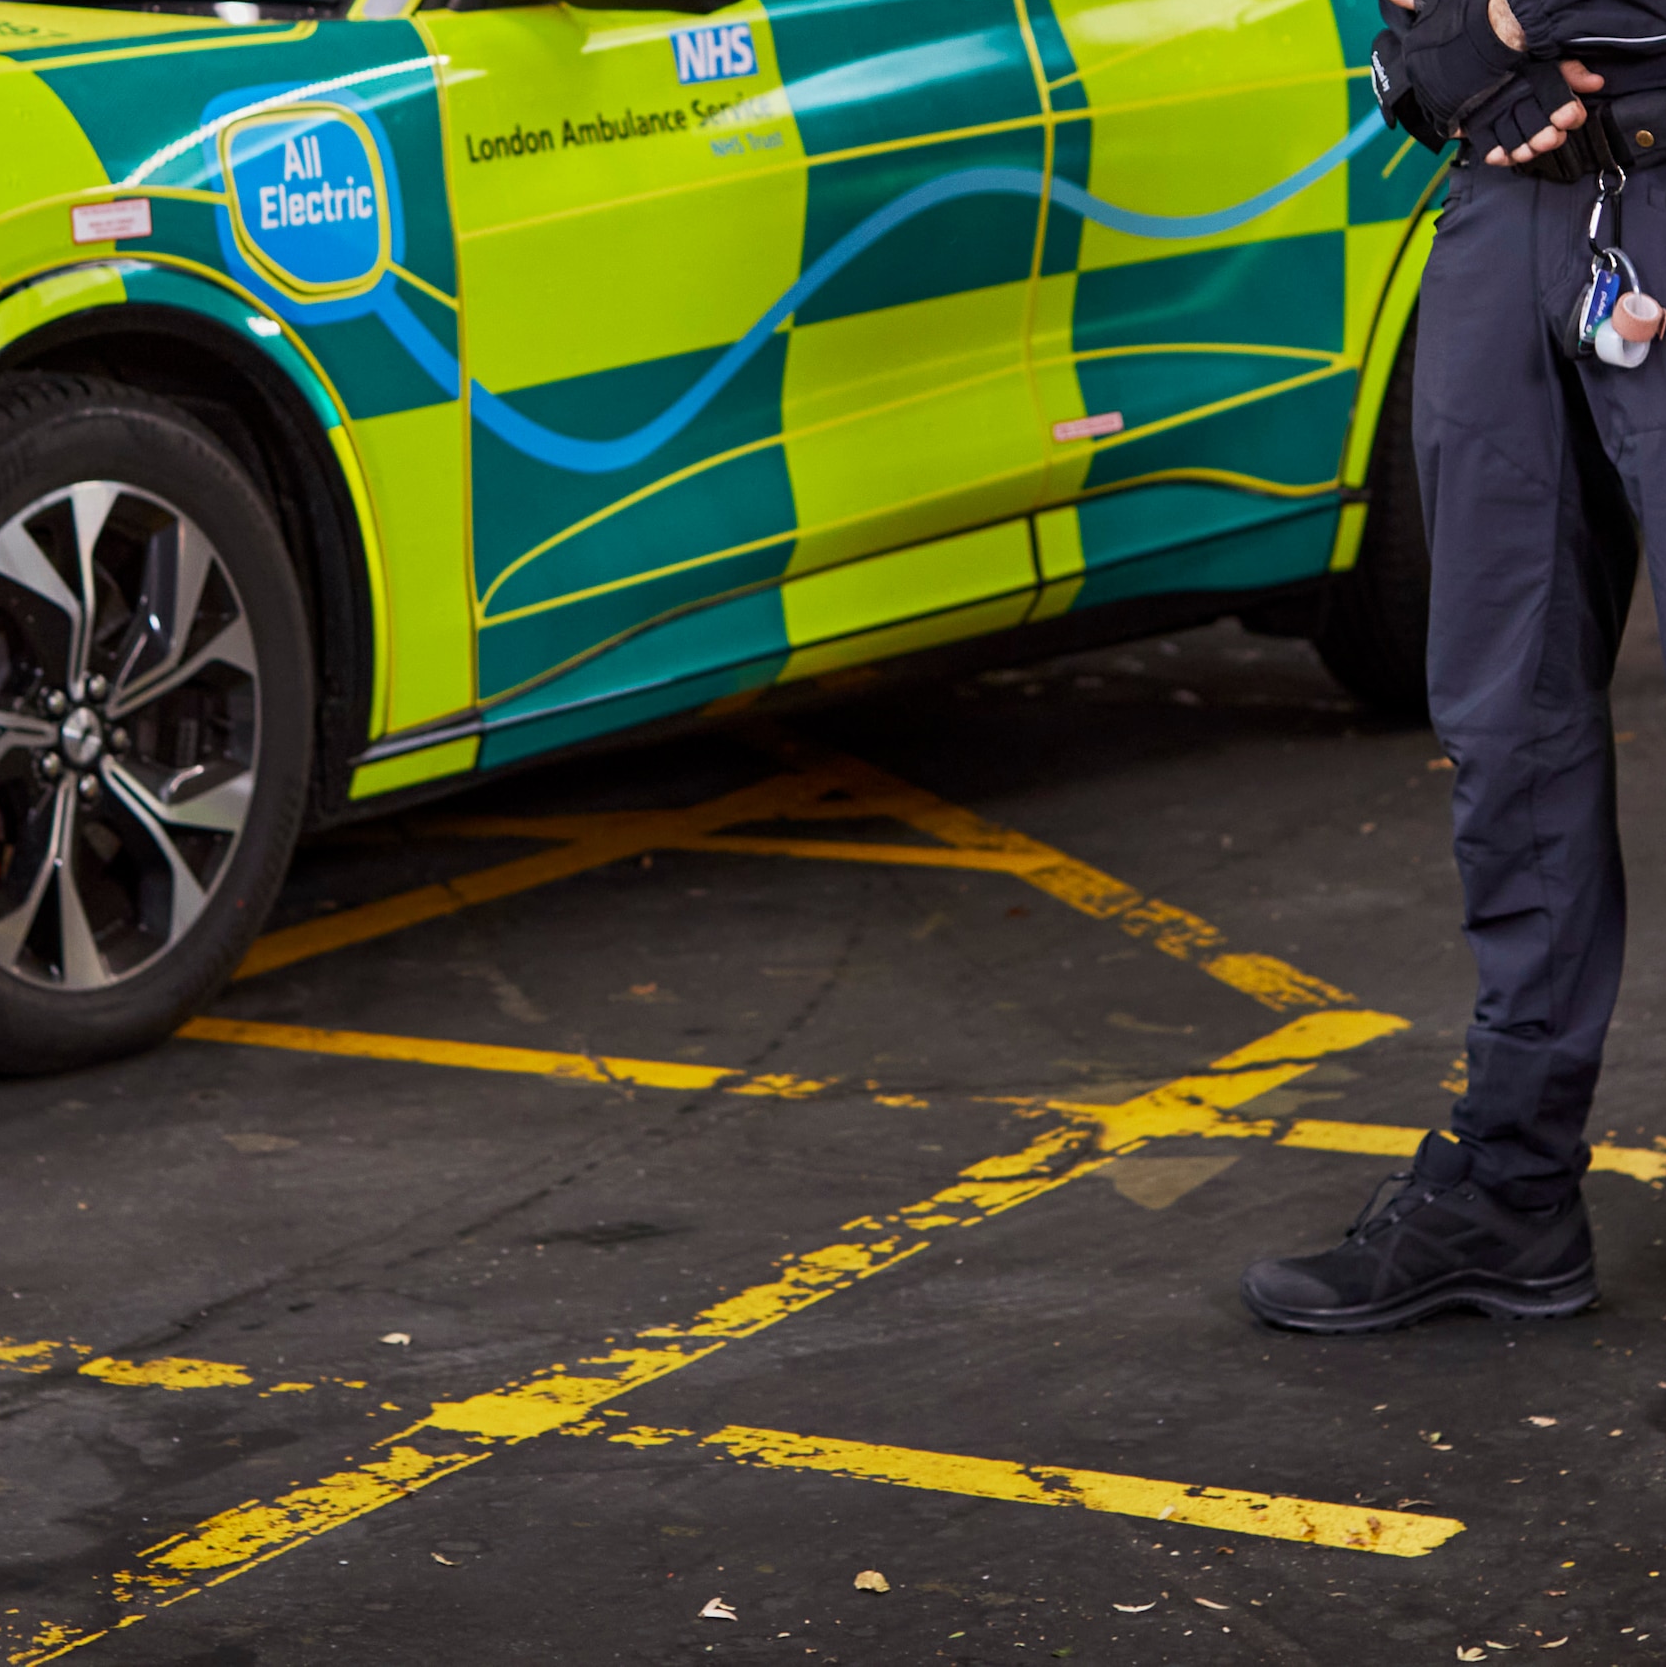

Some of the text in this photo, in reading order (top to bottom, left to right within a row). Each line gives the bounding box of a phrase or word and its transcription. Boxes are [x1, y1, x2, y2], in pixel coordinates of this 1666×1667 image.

[676, 25, 755, 82] NHS
[465, 91, 773, 164] London Ambulance Service
[284, 135, 322, 182] All
[259, 176, 373, 230] Electric
